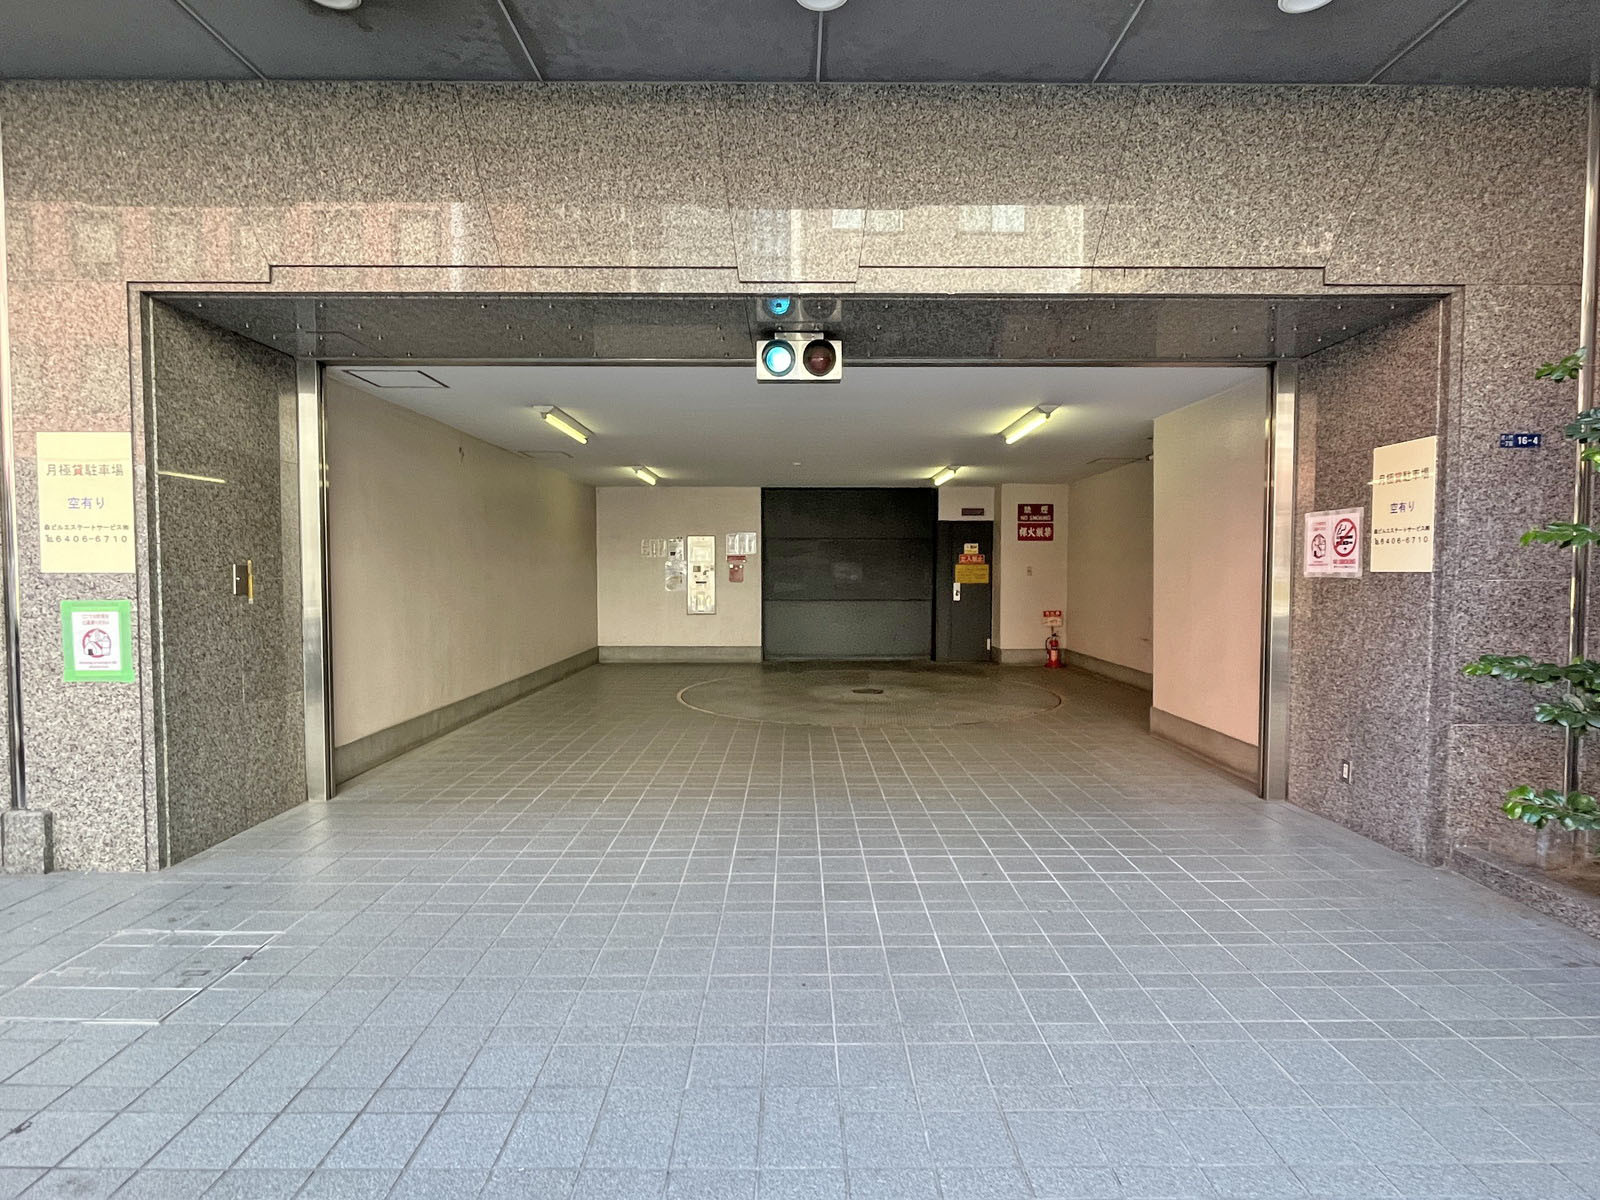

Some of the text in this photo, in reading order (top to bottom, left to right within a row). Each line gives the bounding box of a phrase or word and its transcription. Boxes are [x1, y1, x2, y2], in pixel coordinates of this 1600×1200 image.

[1517, 436, 1538, 445] 16-4
[46, 464, 124, 476] 月極貸駐車場
[67, 497, 105, 509] 空有り
[1390, 501, 1415, 514] 空有り
